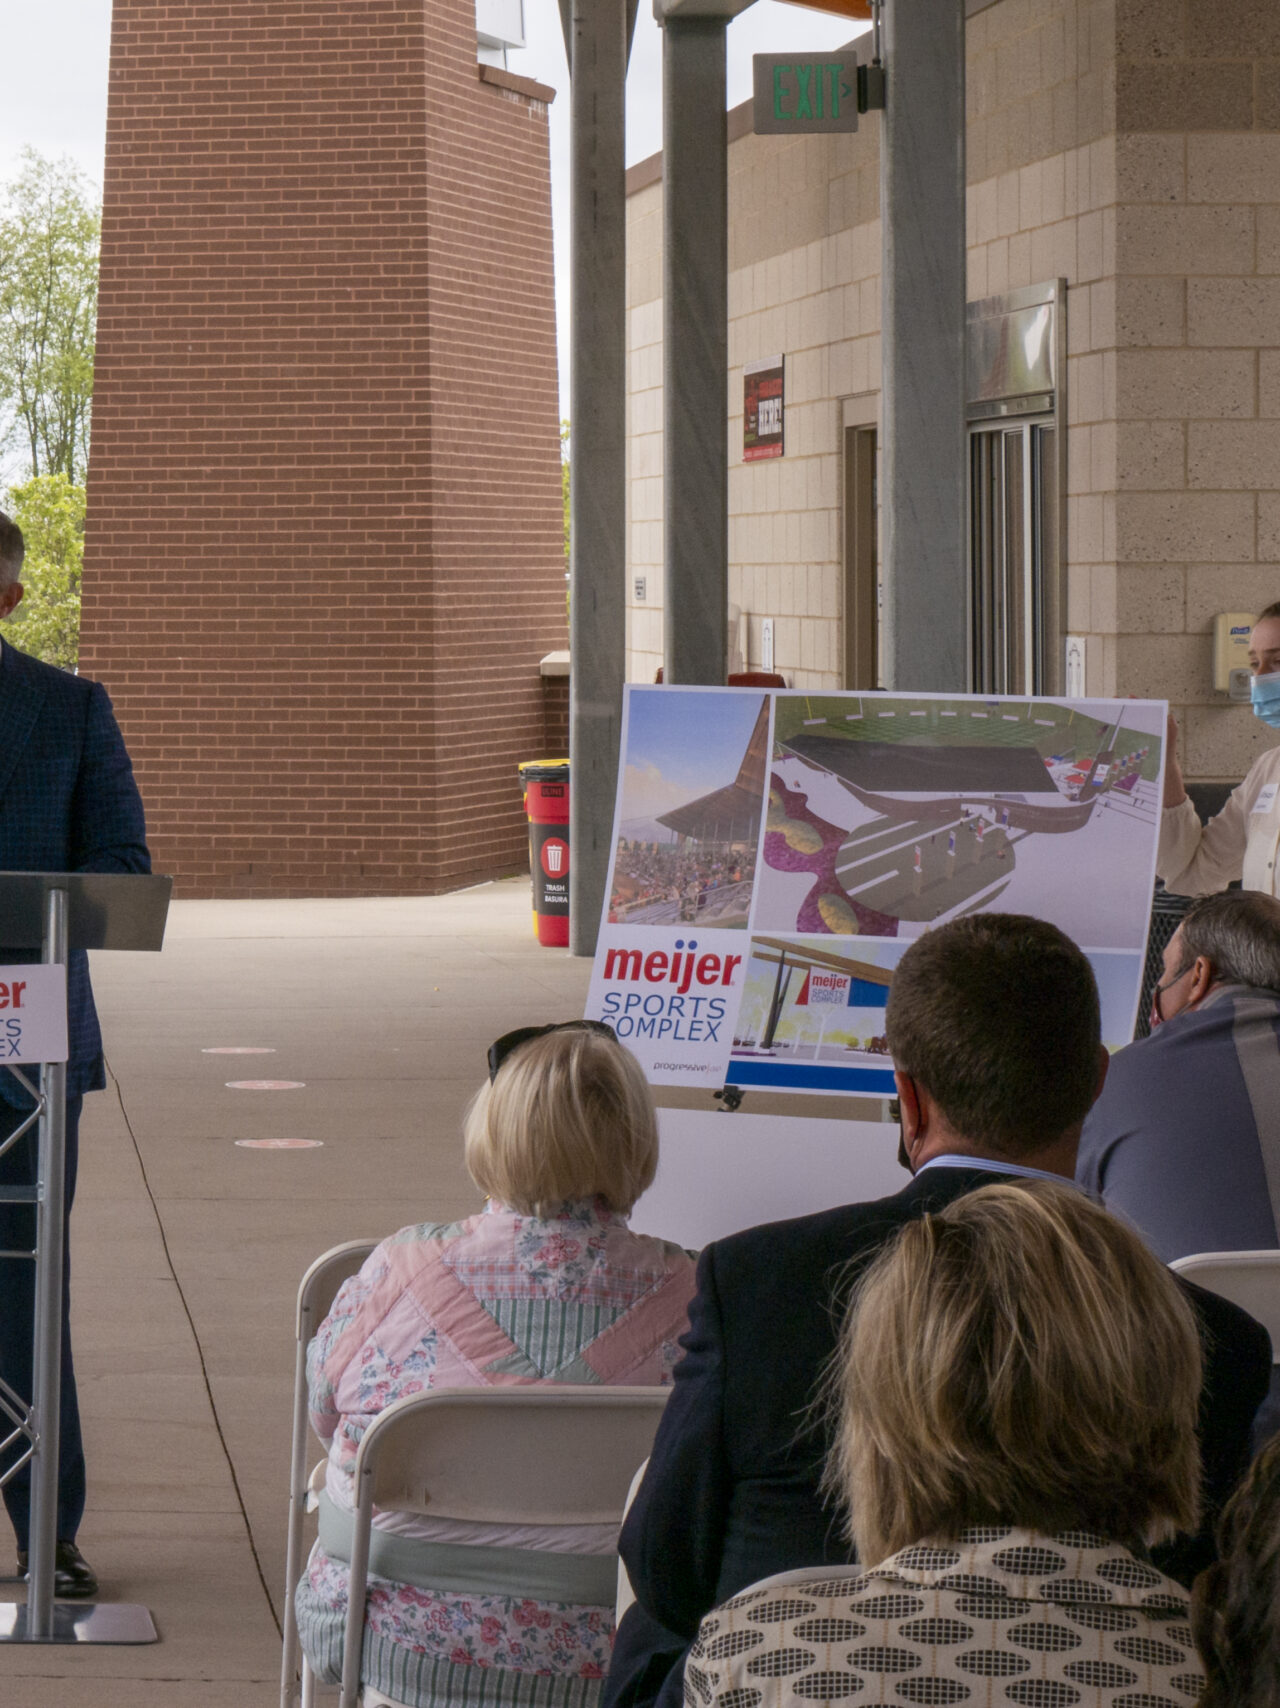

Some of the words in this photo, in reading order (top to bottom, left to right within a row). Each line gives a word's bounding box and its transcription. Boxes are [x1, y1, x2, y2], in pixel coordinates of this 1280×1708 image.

[773, 64, 844, 119] EXIT
[545, 895, 568, 903] BASURA
[546, 884, 565, 892] TRASH
[603, 939, 742, 994] meijer
[812, 973, 848, 990] meijer
[602, 992, 726, 1019] SPORTS
